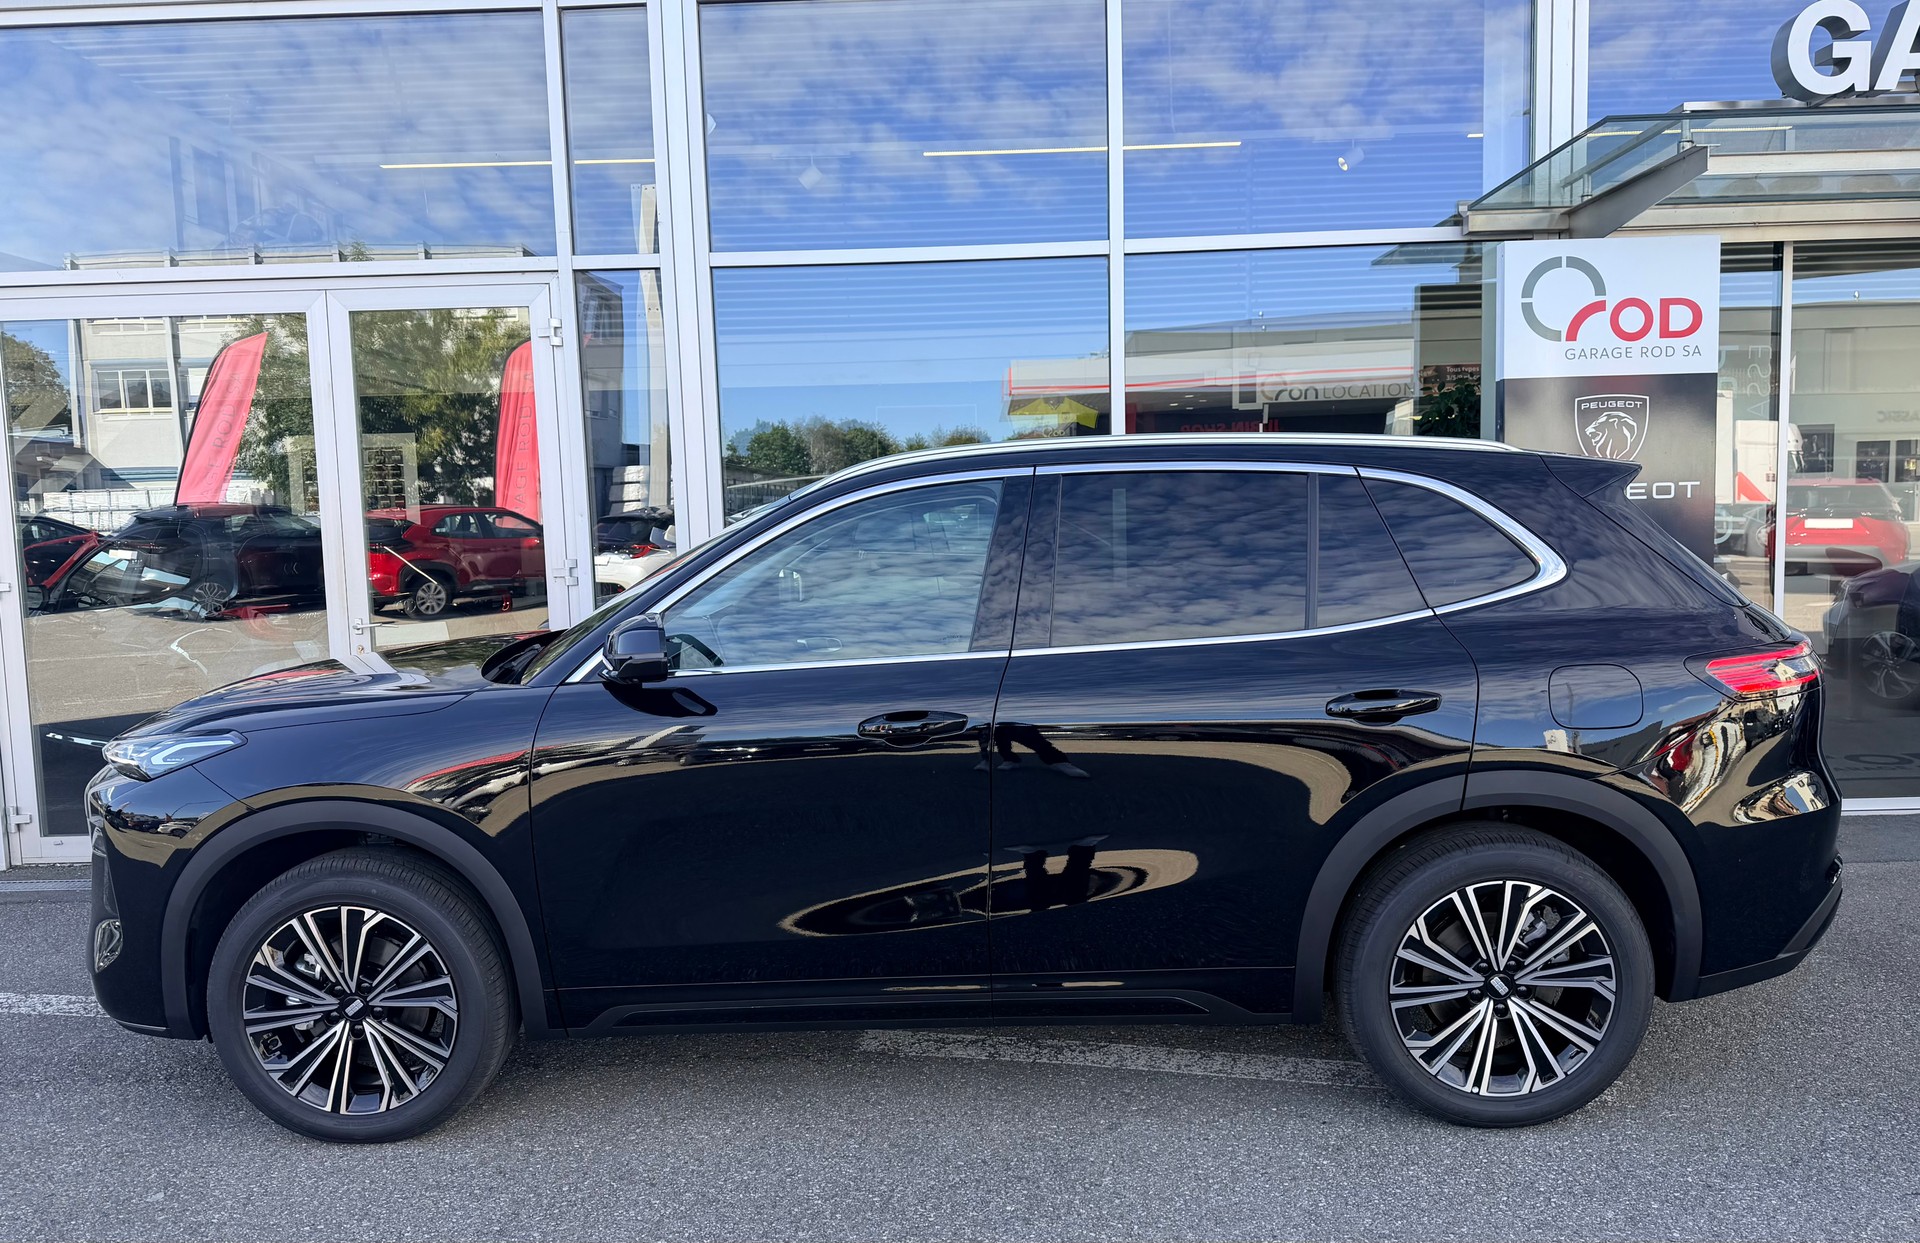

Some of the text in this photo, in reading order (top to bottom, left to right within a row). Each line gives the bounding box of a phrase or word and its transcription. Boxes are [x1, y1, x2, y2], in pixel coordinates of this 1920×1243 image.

[1565, 344, 1702, 361] GARAGE ROD SA
[1581, 400, 1643, 410] PEUGEOT
